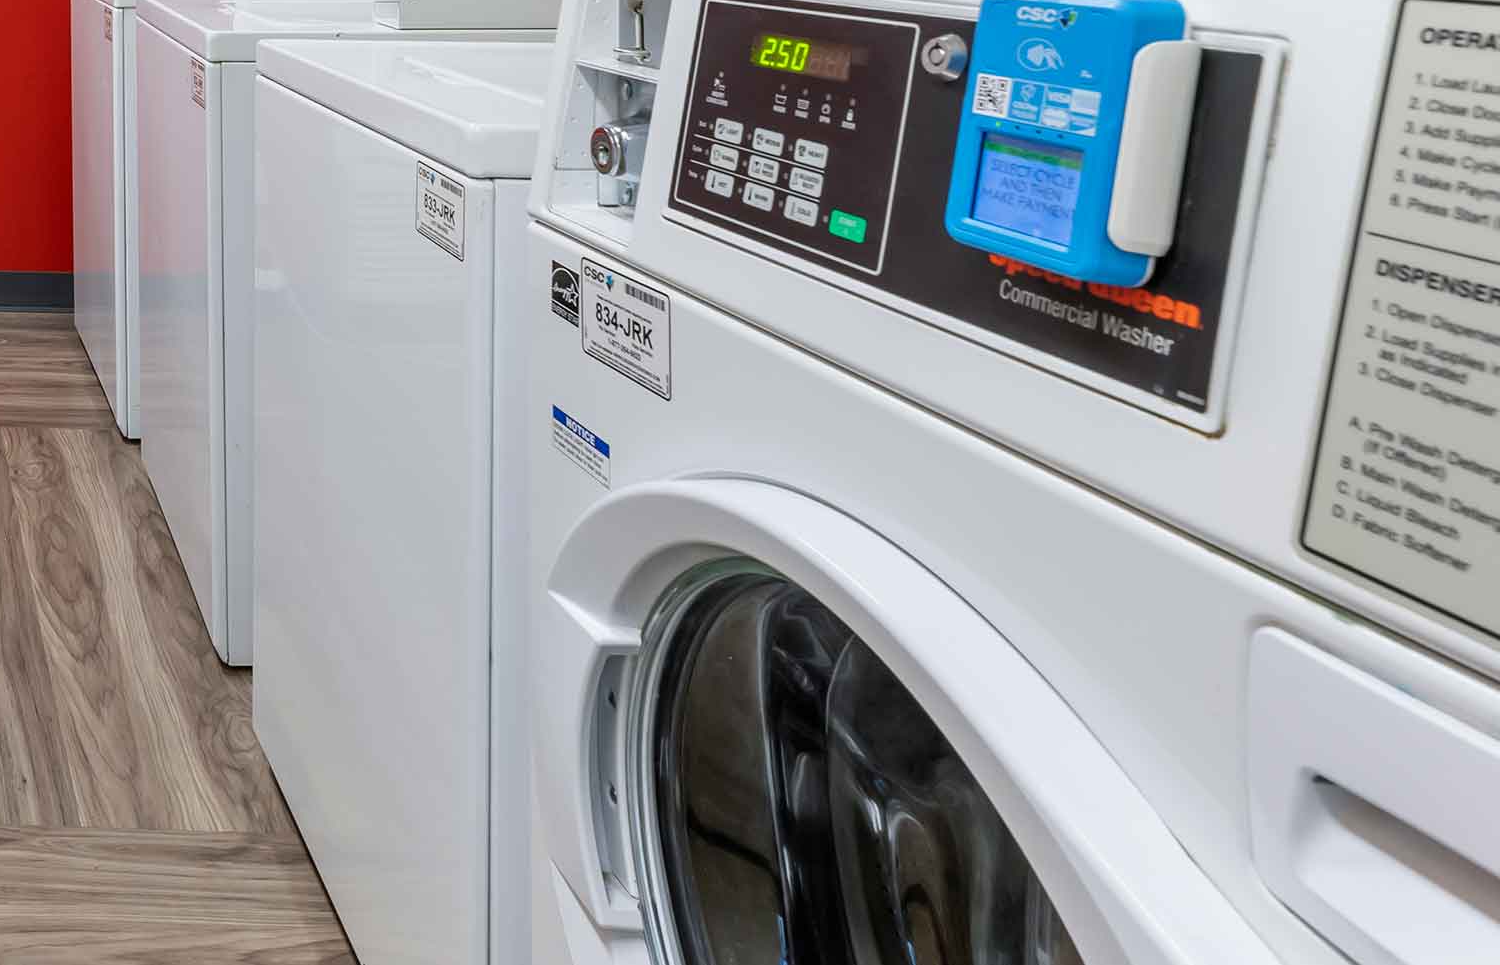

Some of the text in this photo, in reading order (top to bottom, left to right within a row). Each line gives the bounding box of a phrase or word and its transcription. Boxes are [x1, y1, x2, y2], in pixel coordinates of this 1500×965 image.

[1016, 6, 1057, 22] CSC
[759, 38, 809, 71] 2.50
[1421, 27, 1500, 52] OPERA
[1431, 73, 1468, 91] Load
[1426, 99, 1468, 116] Close
[1421, 124, 1450, 140] Add
[1417, 148, 1456, 167] Make
[990, 158, 1076, 189] SELECT CYCLE
[1412, 172, 1451, 191] Make
[1000, 177, 1061, 202] AND THEN
[424, 193, 455, 227] 833-JRK
[1406, 197, 1447, 217] Press
[1452, 207, 1490, 226] Start
[584, 266, 605, 283] CSC
[595, 302, 653, 349] 834-JRK
[999, 278, 1175, 356] Commercial Washer
[1388, 303, 1427, 324] Open
[1382, 328, 1419, 351] Load
[1422, 341, 1487, 372] Supplies
[1378, 348, 1469, 385] as Indicated
[1375, 367, 1417, 391] Close
[1420, 381, 1498, 416] Dispenser
[566, 416, 596, 446] NOTICE
[1368, 422, 1395, 442] Pre
[1399, 433, 1443, 458] Wash
[1382, 445, 1447, 482] Offered)
[1361, 463, 1397, 485] Main
[1400, 479, 1445, 505] Wash
[1356, 489, 1402, 516] Liquid
[1404, 508, 1461, 539] Bleach
[1353, 511, 1400, 543] Fabric
[1403, 534, 1471, 571] Softener
